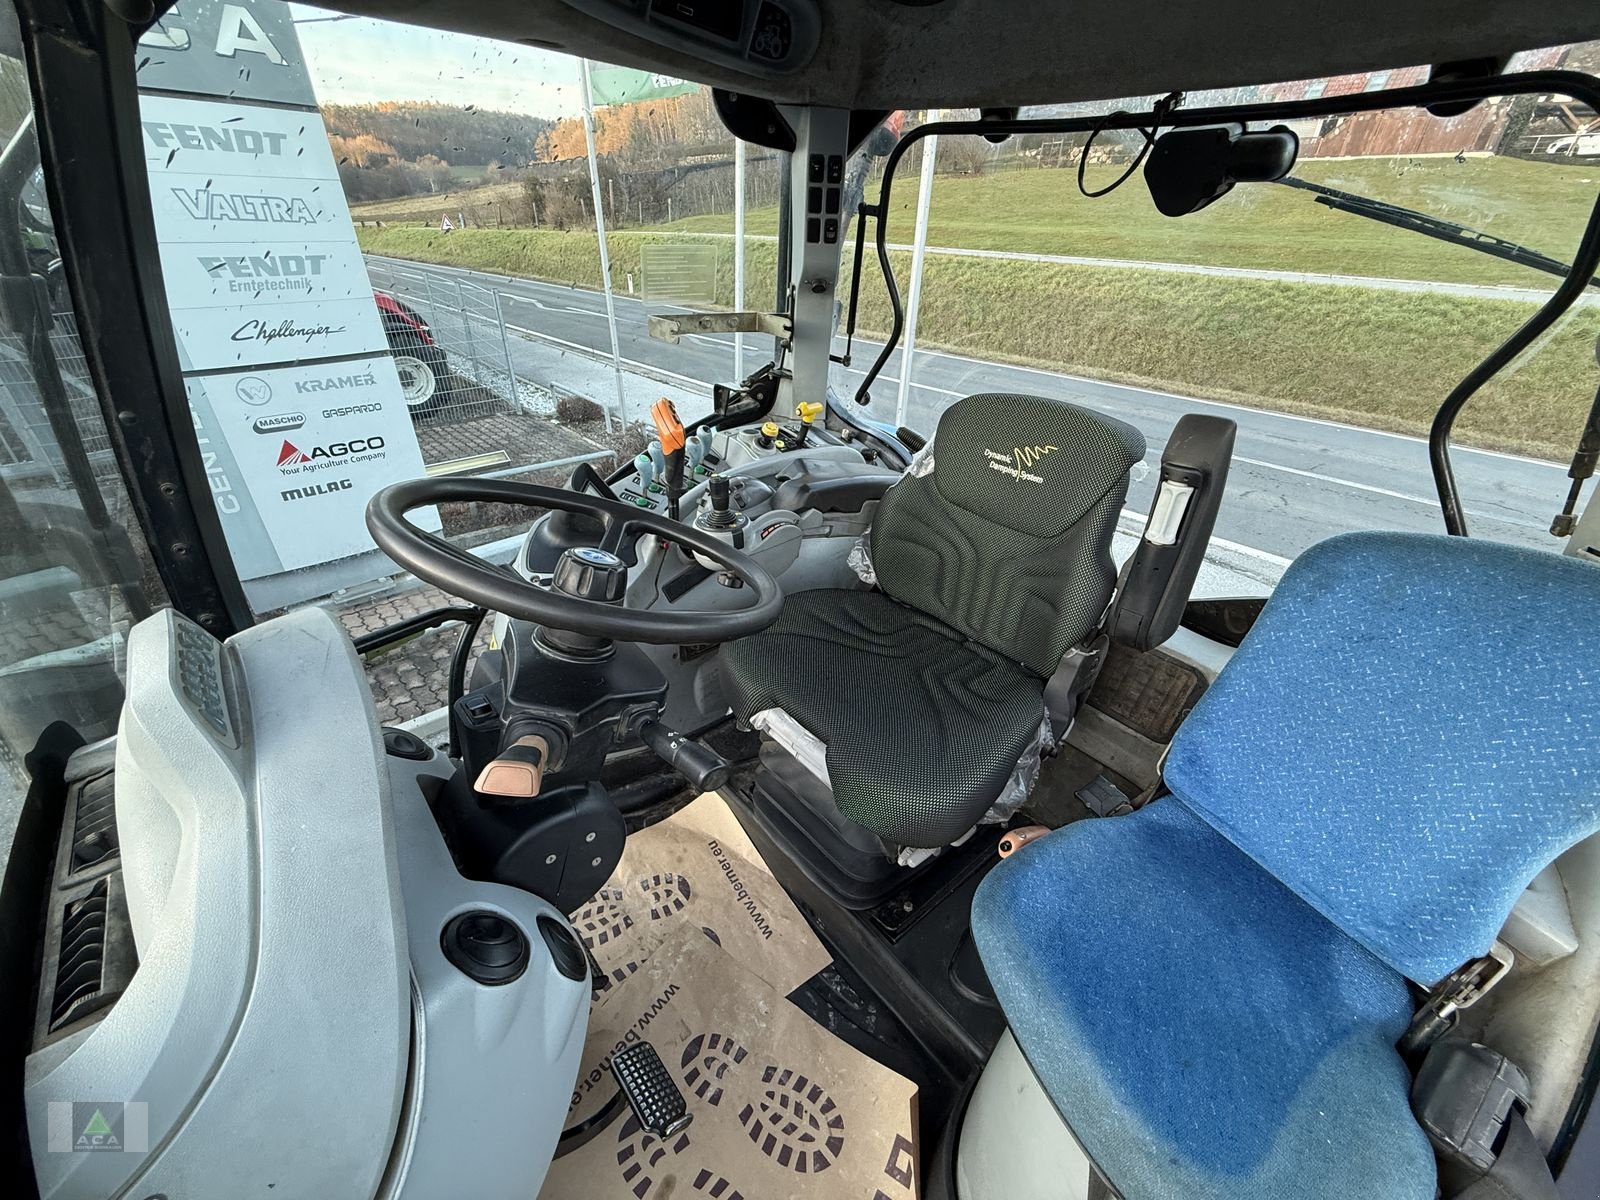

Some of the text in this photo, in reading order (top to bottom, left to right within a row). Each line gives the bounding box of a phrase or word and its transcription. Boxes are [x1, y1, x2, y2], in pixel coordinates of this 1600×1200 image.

[144, 122, 287, 155] FENDT
[170, 187, 317, 223] VALTRA
[197, 255, 326, 278] FENDT
[229, 278, 312, 292] Erntetechnik
[230, 319, 347, 344] Challenger
[295, 374, 377, 394] KRAMER
[259, 414, 304, 427] MASCHIO
[322, 402, 382, 418] GASPARDO
[311, 436, 385, 459] AGCO
[984, 448, 1012, 463] Dynamic
[280, 450, 386, 476] Your Agriculture Company
[989, 460, 1017, 477] Damping
[708, 839, 774, 941] www.berner.eu
[569, 983, 681, 1113] www.berner.e
